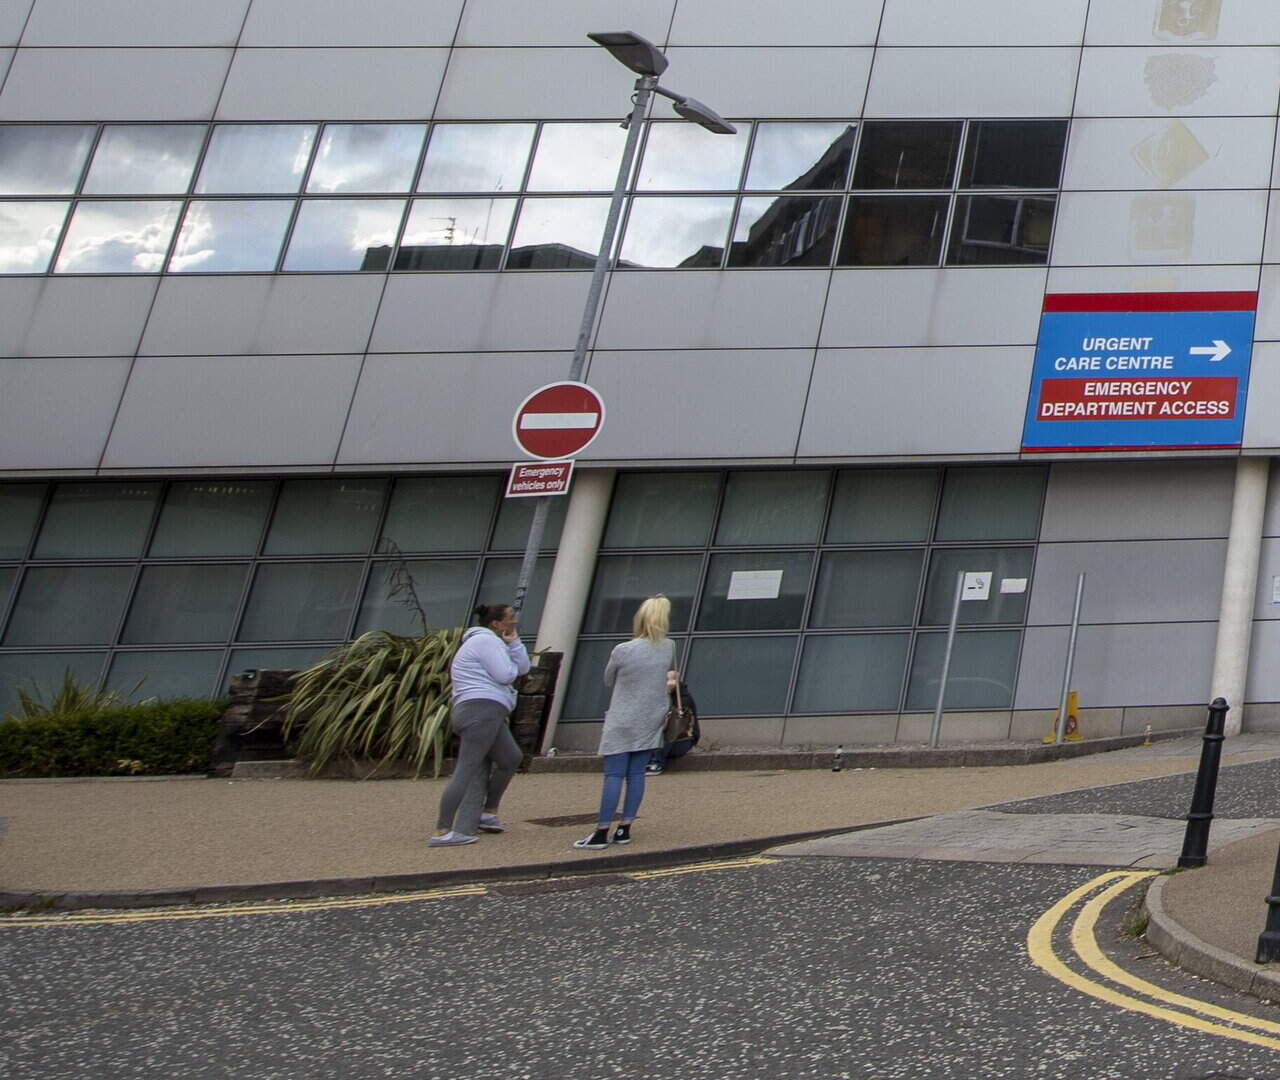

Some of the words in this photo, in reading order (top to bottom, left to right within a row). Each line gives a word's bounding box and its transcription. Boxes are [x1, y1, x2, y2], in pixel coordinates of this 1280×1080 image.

[1083, 337, 1152, 351] URGENT
[1055, 357, 1101, 370] CARE
[1106, 356, 1174, 369] CENTRE
[1084, 381, 1191, 396] EMERGENCY
[1041, 401, 1156, 416] DEPARTMENT
[1160, 401, 1230, 415] ACCESS
[519, 467, 564, 478] Emergency
[512, 480, 545, 490] vehicles
[546, 479, 565, 490] only
